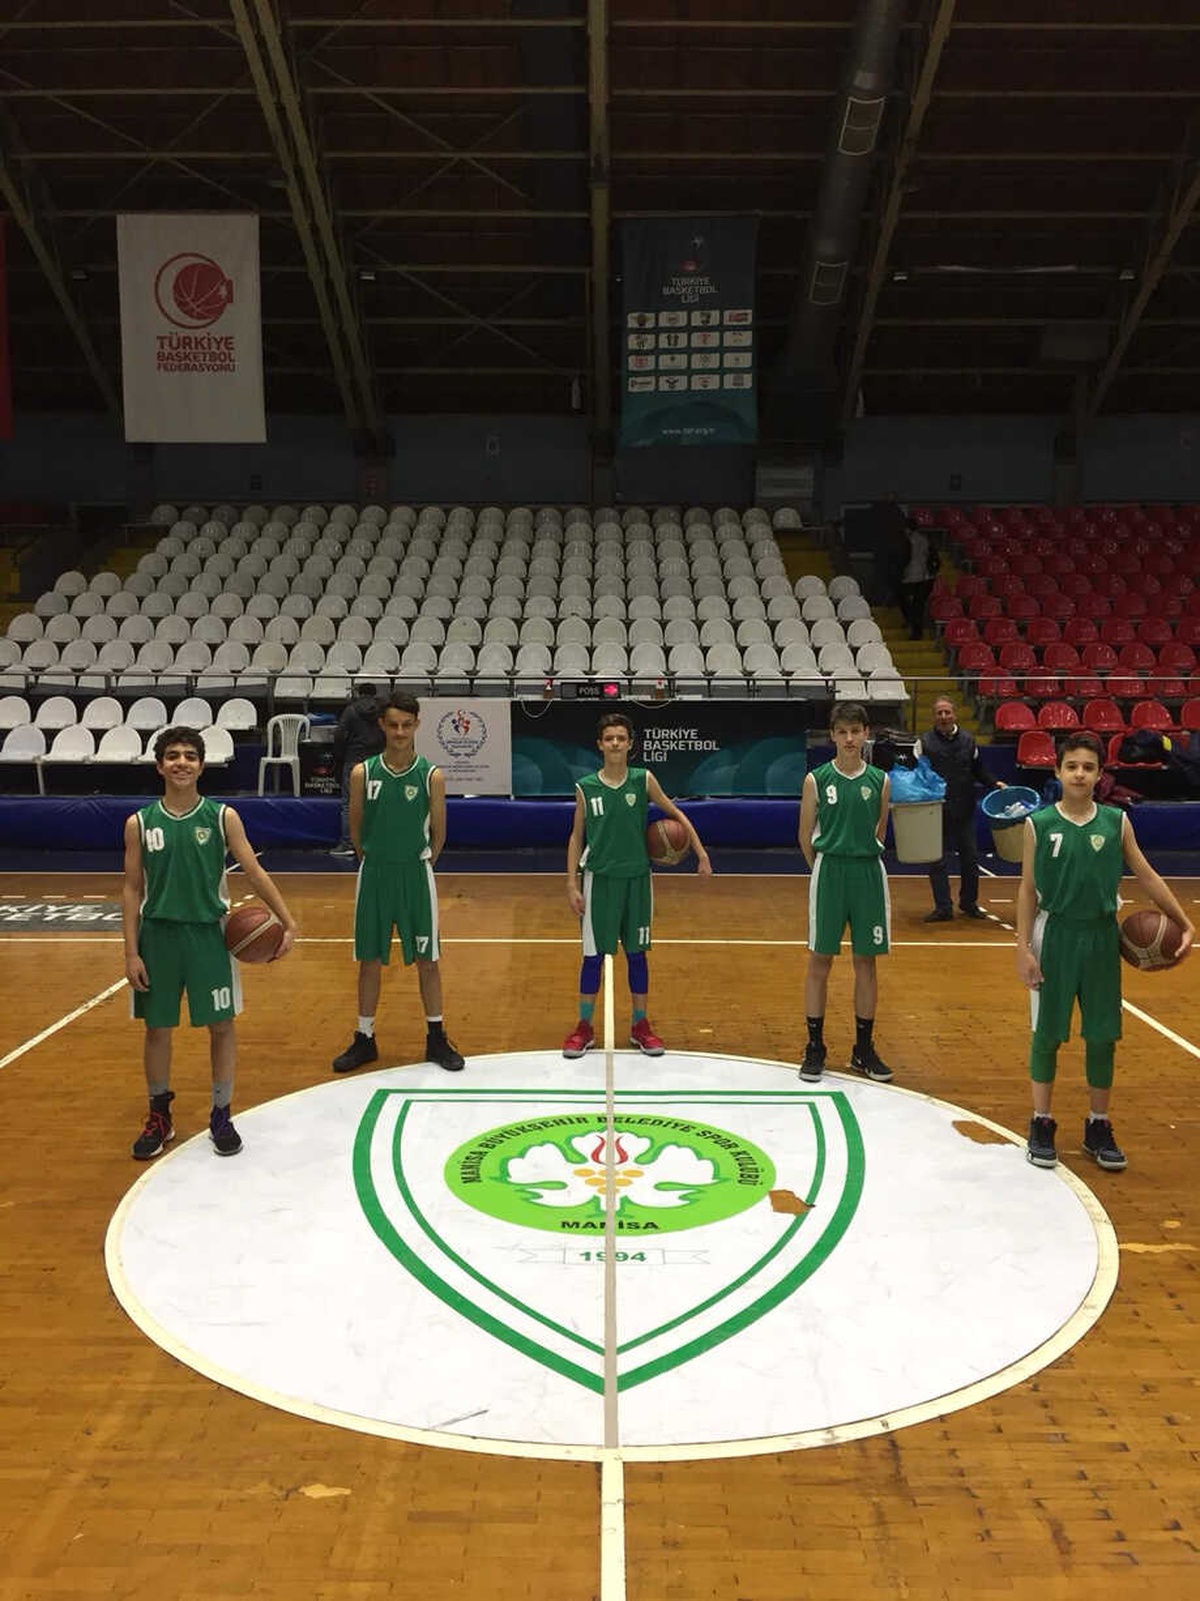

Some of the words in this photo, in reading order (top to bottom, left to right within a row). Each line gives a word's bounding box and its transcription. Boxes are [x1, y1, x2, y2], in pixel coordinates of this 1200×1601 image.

[156, 331, 235, 350] TÜRKİYE
[156, 351, 236, 363] BASKETBOL
[156, 362, 236, 373] FEDERASYONU
[643, 727, 699, 740] TÜRKİYE
[643, 740, 721, 751] BASKETBOL
[367, 780, 382, 800] 17
[826, 784, 838, 805] 9
[591, 797, 604, 816] 11
[146, 827, 165, 852] 10
[1050, 833, 1063, 858] 7
[416, 936, 430, 954] 17
[638, 926, 650, 945] 11
[873, 926, 884, 945] 9
[212, 987, 231, 1011] 10
[695, 1129, 740, 1150] SPOR
[579, 1251, 648, 1262] 1994
